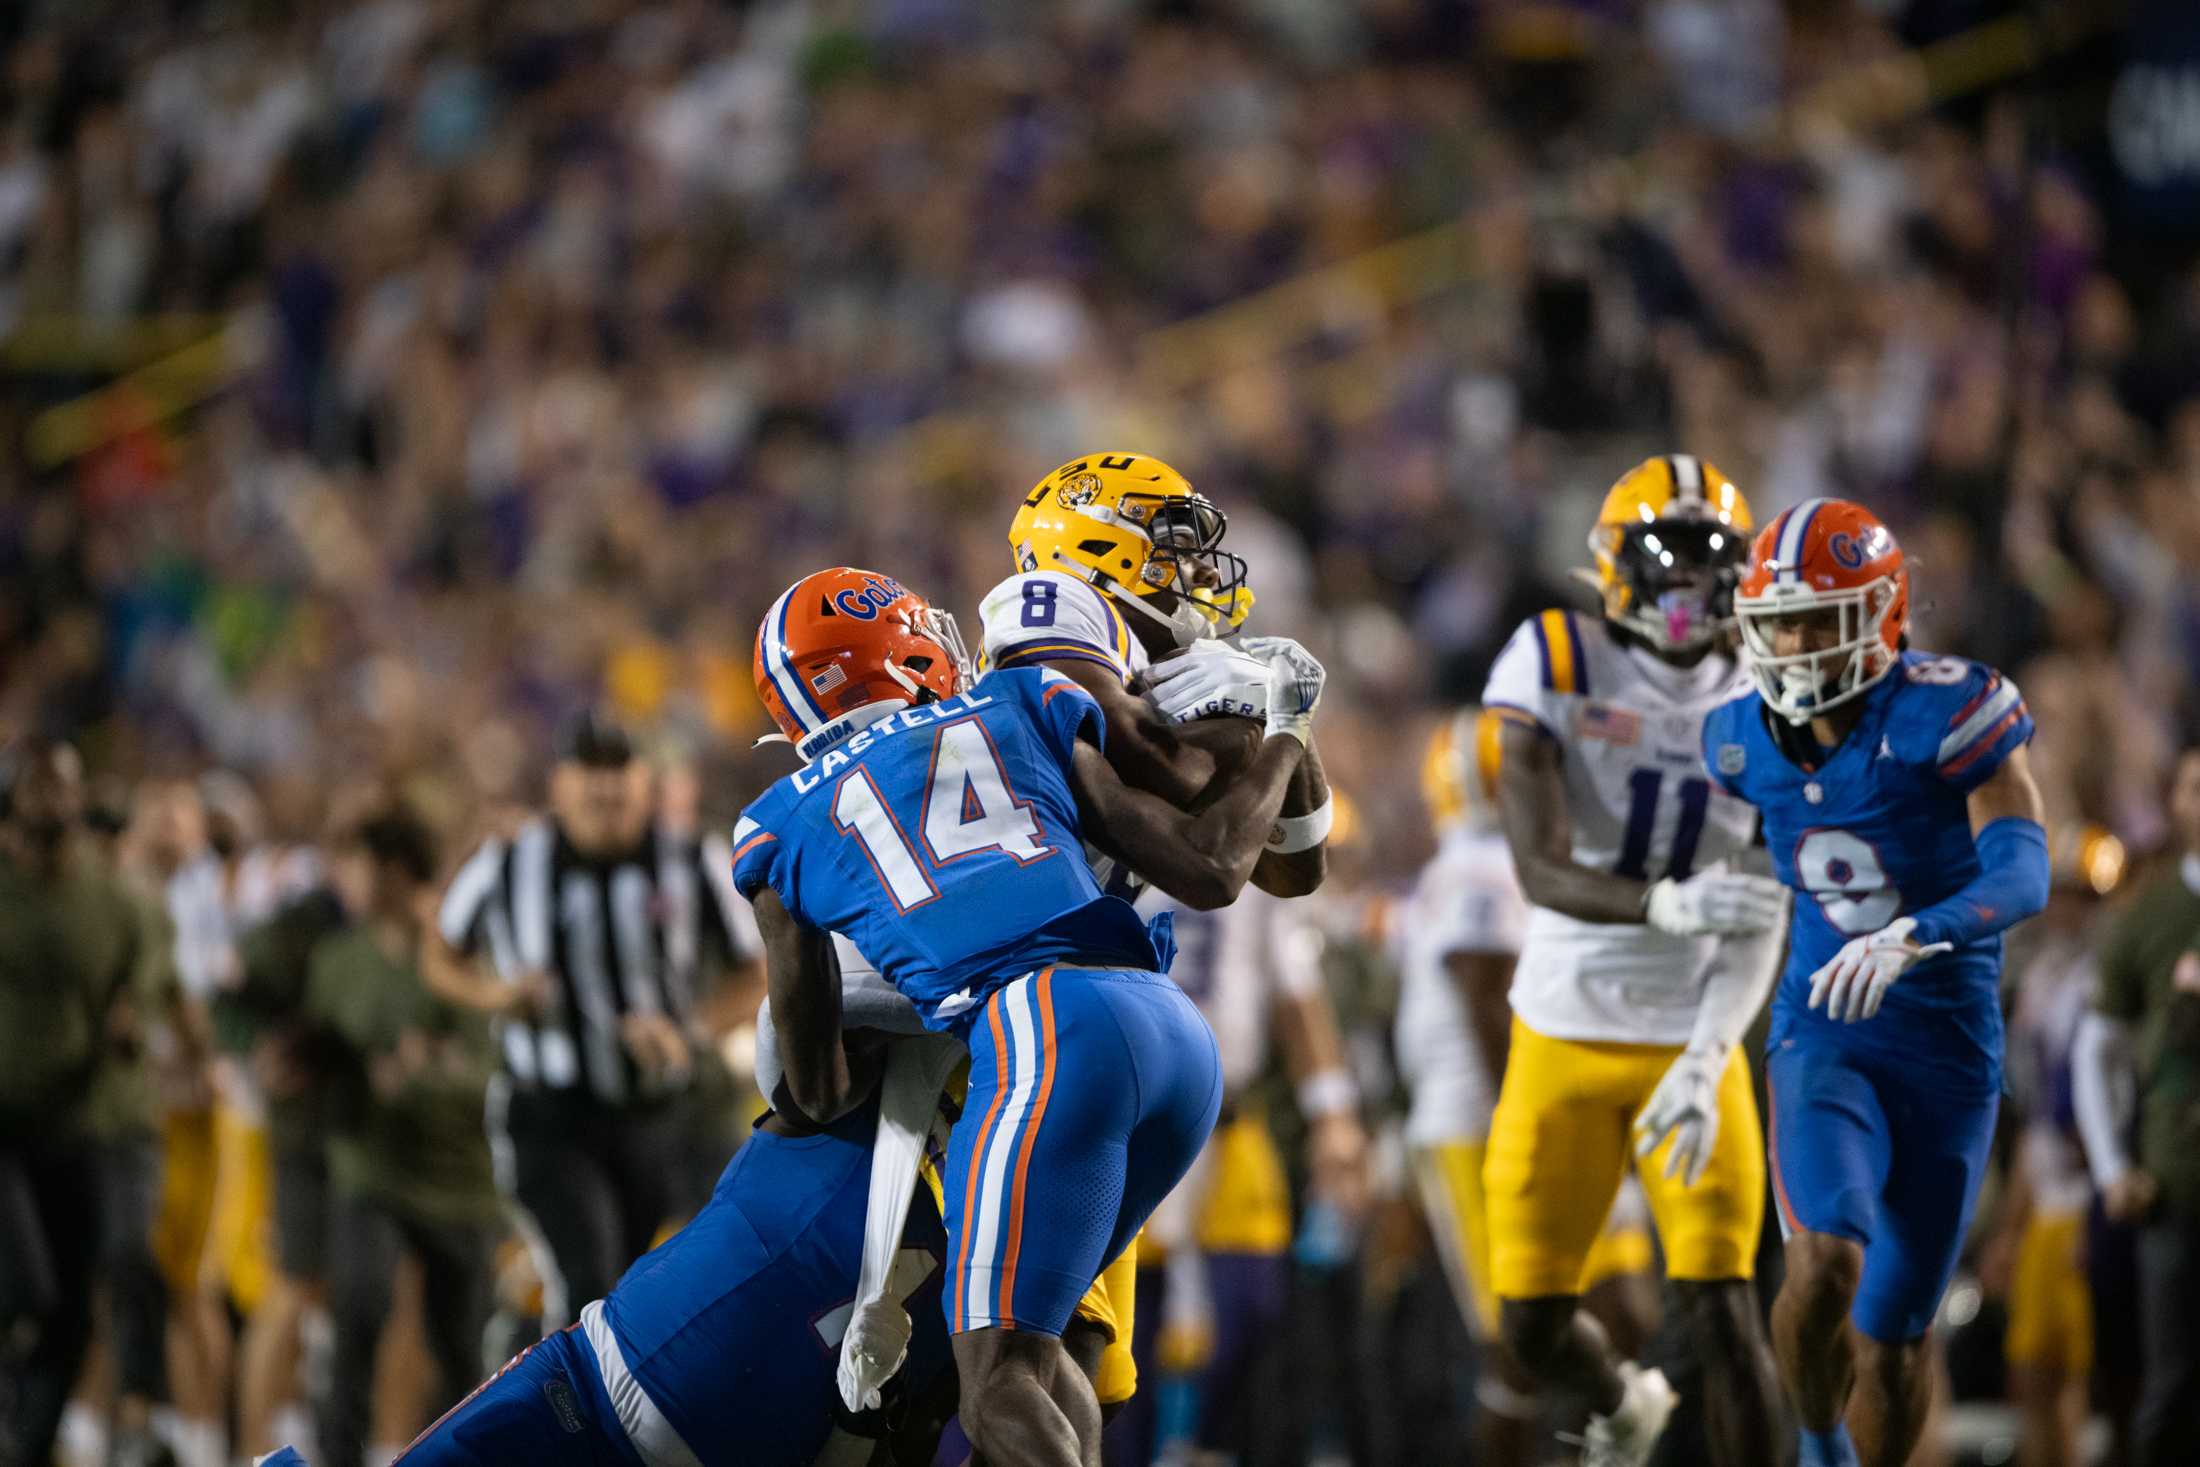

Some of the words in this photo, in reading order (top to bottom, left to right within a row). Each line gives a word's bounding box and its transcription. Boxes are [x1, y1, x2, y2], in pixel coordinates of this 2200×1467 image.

[1022, 580, 1058, 628] 8
[790, 690, 993, 795] CASTELL
[830, 714, 1058, 917] 14
[1611, 765, 1711, 885] 11
[1793, 825, 1902, 938] 8
